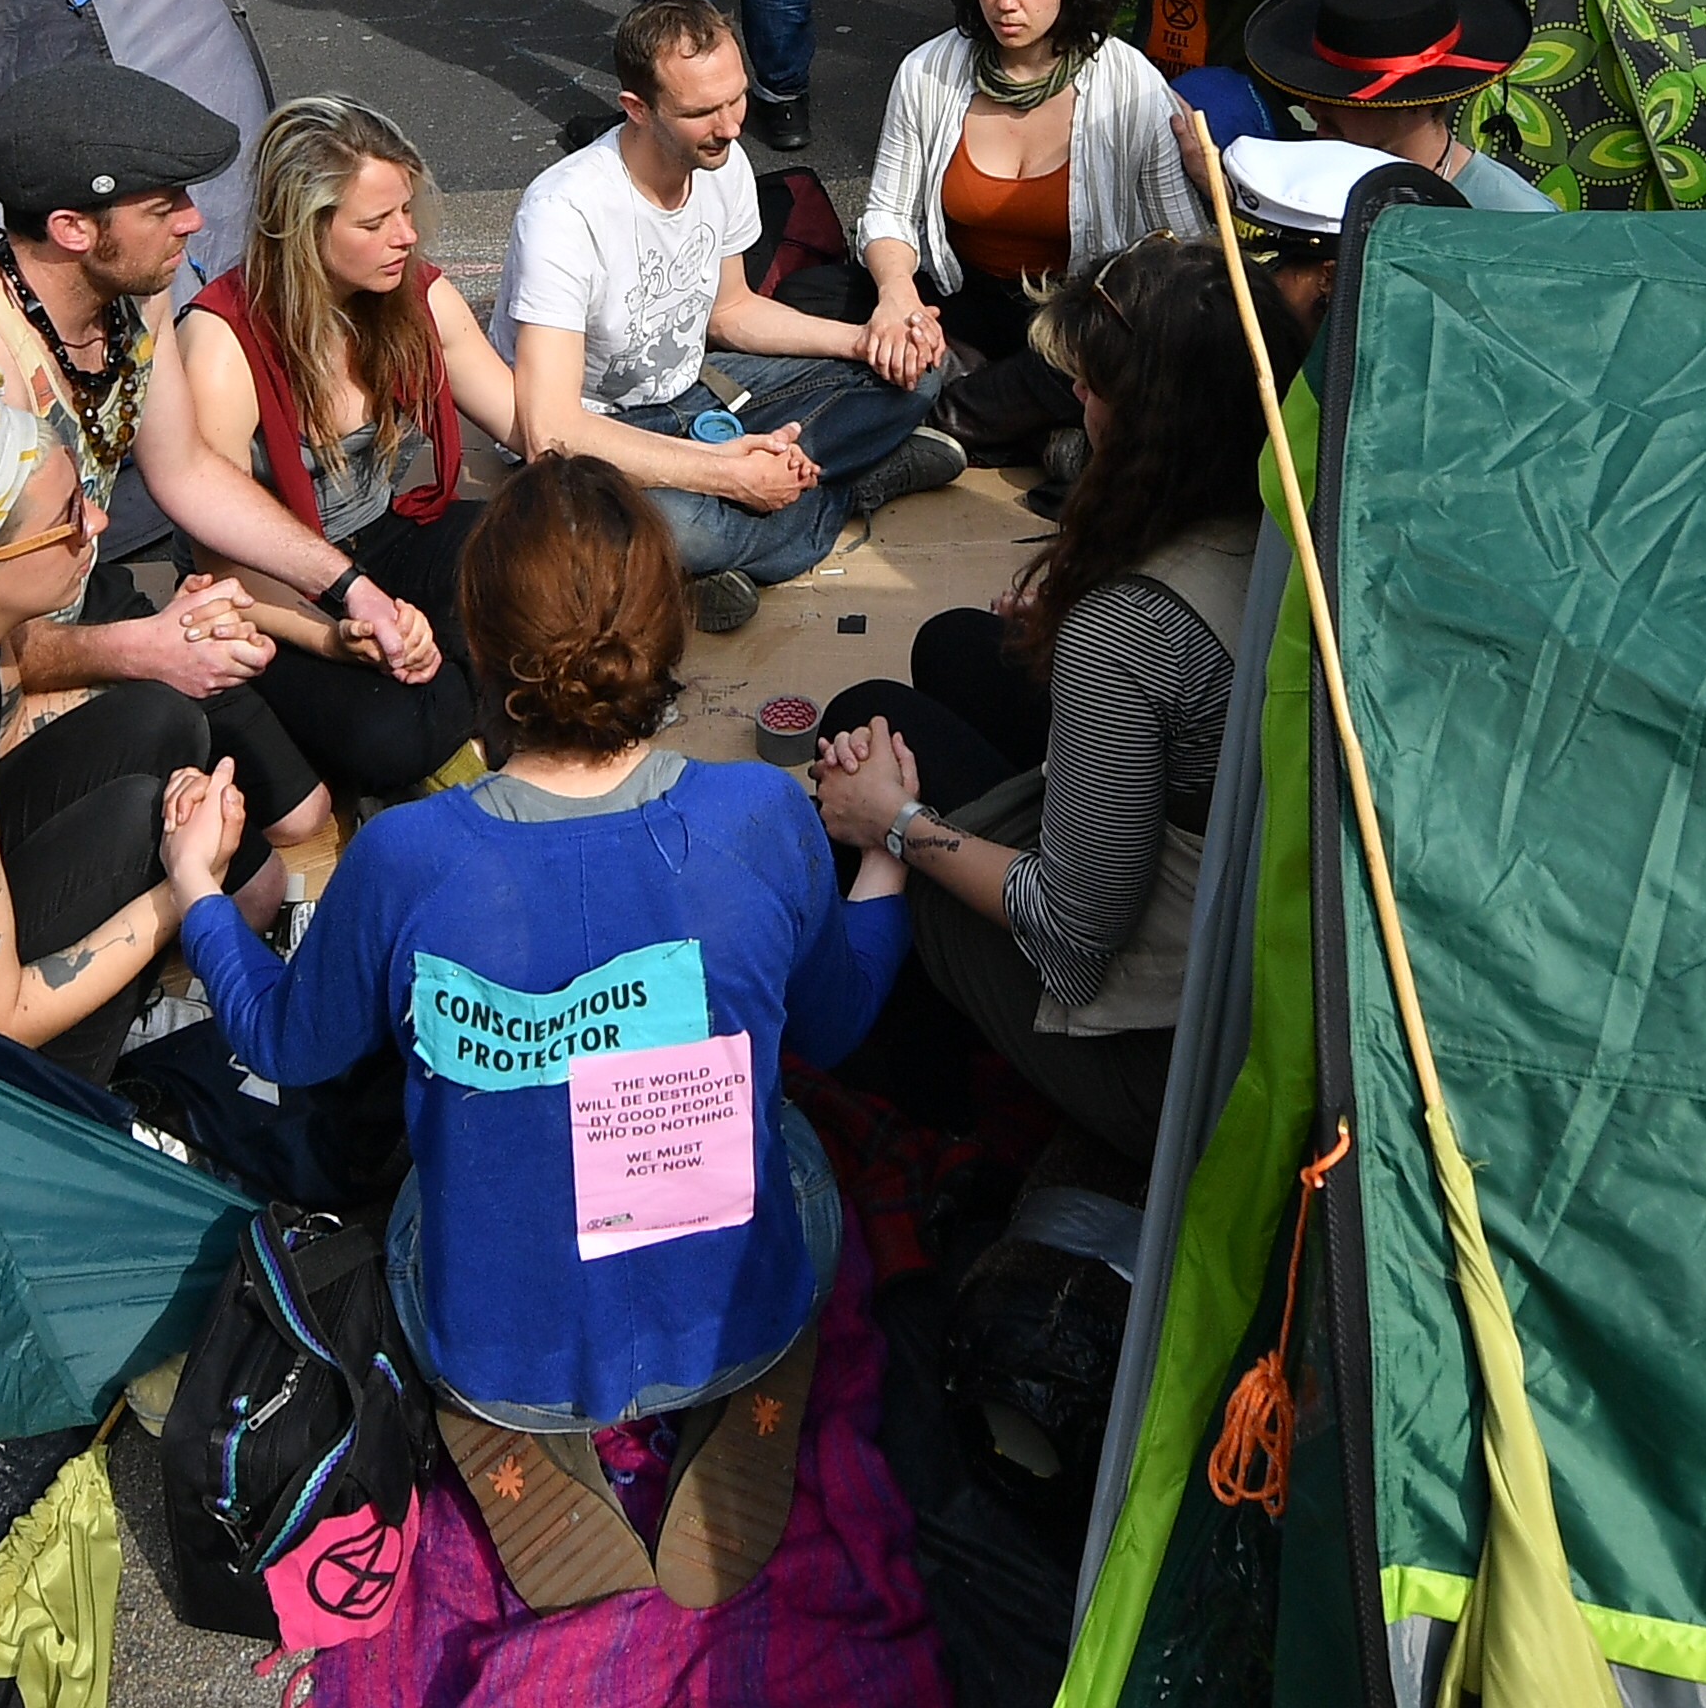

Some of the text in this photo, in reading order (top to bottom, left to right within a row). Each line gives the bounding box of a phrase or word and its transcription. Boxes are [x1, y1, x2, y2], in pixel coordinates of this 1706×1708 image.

[1163, 30, 1189, 48] TELL
[435, 981, 647, 1043] CONSCIENTIOUS
[457, 1024, 620, 1072] PROTECTOR
[576, 1074, 746, 1113] WILL BE DESTROYED
[612, 1067, 710, 1092] THE WORLD
[587, 1107, 738, 1142] WHO DO NOTHING.
[590, 1090, 734, 1128] BY GOOD PEOPLE
[626, 1156, 705, 1178] ACT NOW.
[627, 1141, 703, 1164] WE MUST
